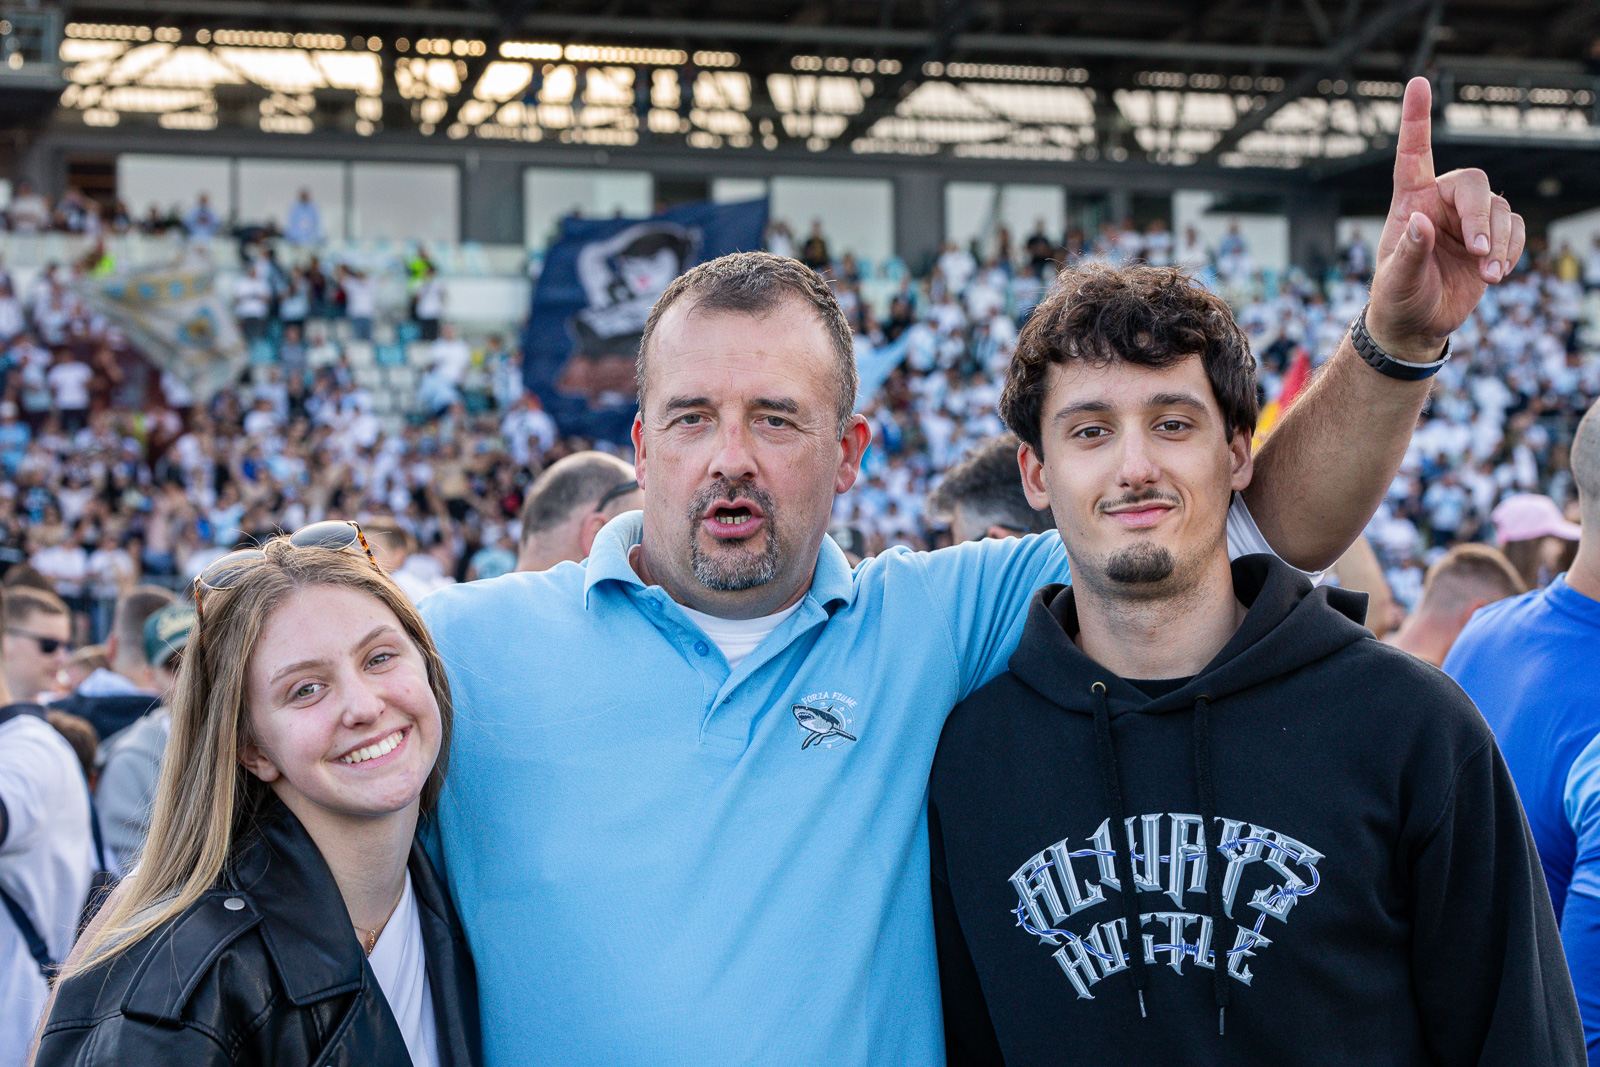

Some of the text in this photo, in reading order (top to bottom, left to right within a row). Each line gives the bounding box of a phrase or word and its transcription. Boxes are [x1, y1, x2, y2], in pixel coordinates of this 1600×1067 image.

[801, 691, 857, 708] FORZA FIUME
[1008, 813, 1325, 945] ALWAYS
